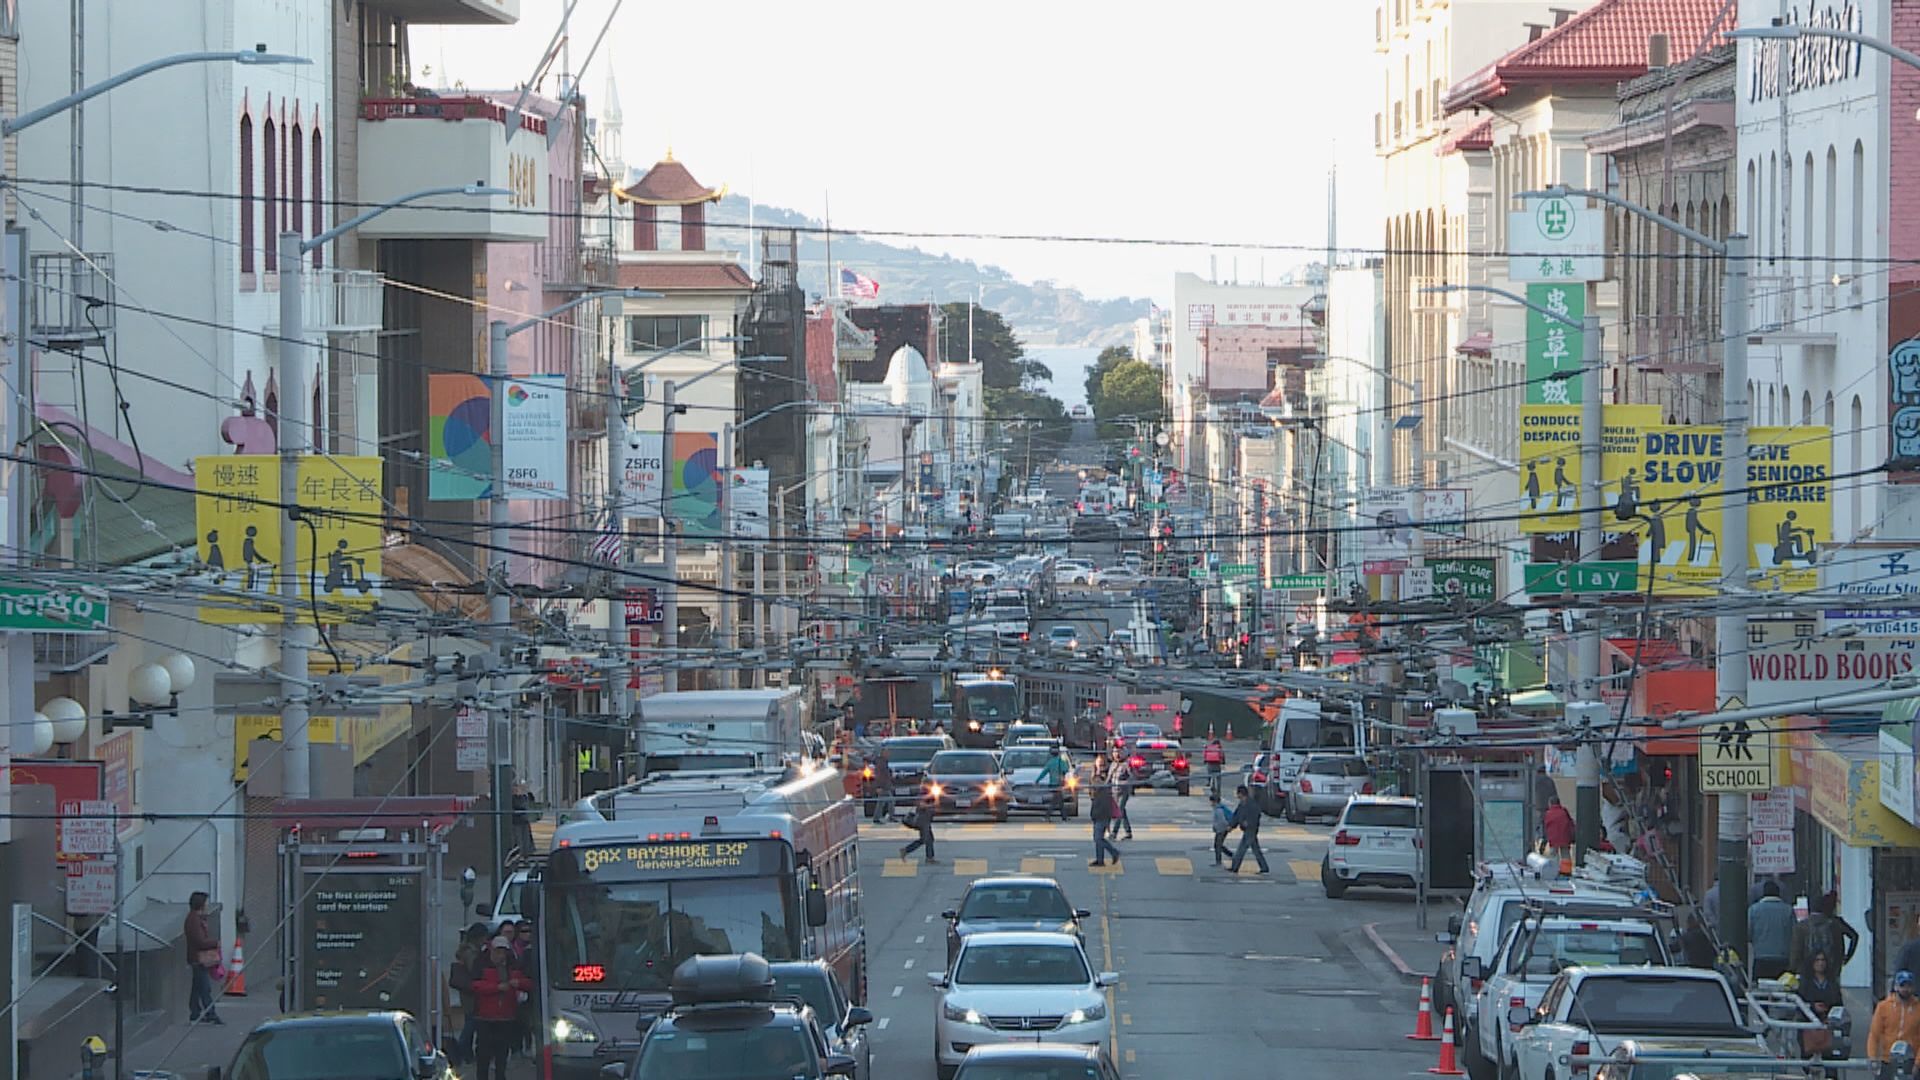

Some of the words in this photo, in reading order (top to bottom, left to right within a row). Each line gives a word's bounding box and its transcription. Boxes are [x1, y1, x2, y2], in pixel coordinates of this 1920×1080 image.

[1523, 415, 1580, 427] CONDUCE
[1523, 431, 1580, 442] DESPACIO
[1602, 426, 1623, 435] RUCE
[1645, 432, 1722, 457] DRIVE
[1747, 444, 1790, 461] GIVE
[625, 458, 661, 470] ZSFG
[213, 463, 260, 488] 慢速
[507, 468, 538, 479] ZSFG
[1644, 460, 1722, 484] SLOW
[1747, 465, 1826, 482] SENIORS
[302, 476, 378, 502] 年長者
[1764, 486, 1826, 502] BRAKE
[1274, 576, 1328, 588] Washingto
[1556, 569, 1621, 589] Clay
[1748, 653, 1829, 681] WORLD
[1836, 652, 1914, 680] BOOKS
[1706, 769, 1766, 786] SCHOOL
[63, 802, 79, 816] NO
[627, 843, 710, 860] BAYSHORE
[716, 841, 748, 856] EXP
[317, 892, 333, 900] The
[335, 892, 352, 900] first
[354, 892, 397, 901] corporate
[317, 903, 336, 911] card
[338, 903, 351, 911] for
[353, 903, 388, 912] startups
[329, 932, 363, 942] personal
[316, 969, 342, 979] Higher
[316, 979, 338, 987] limits
